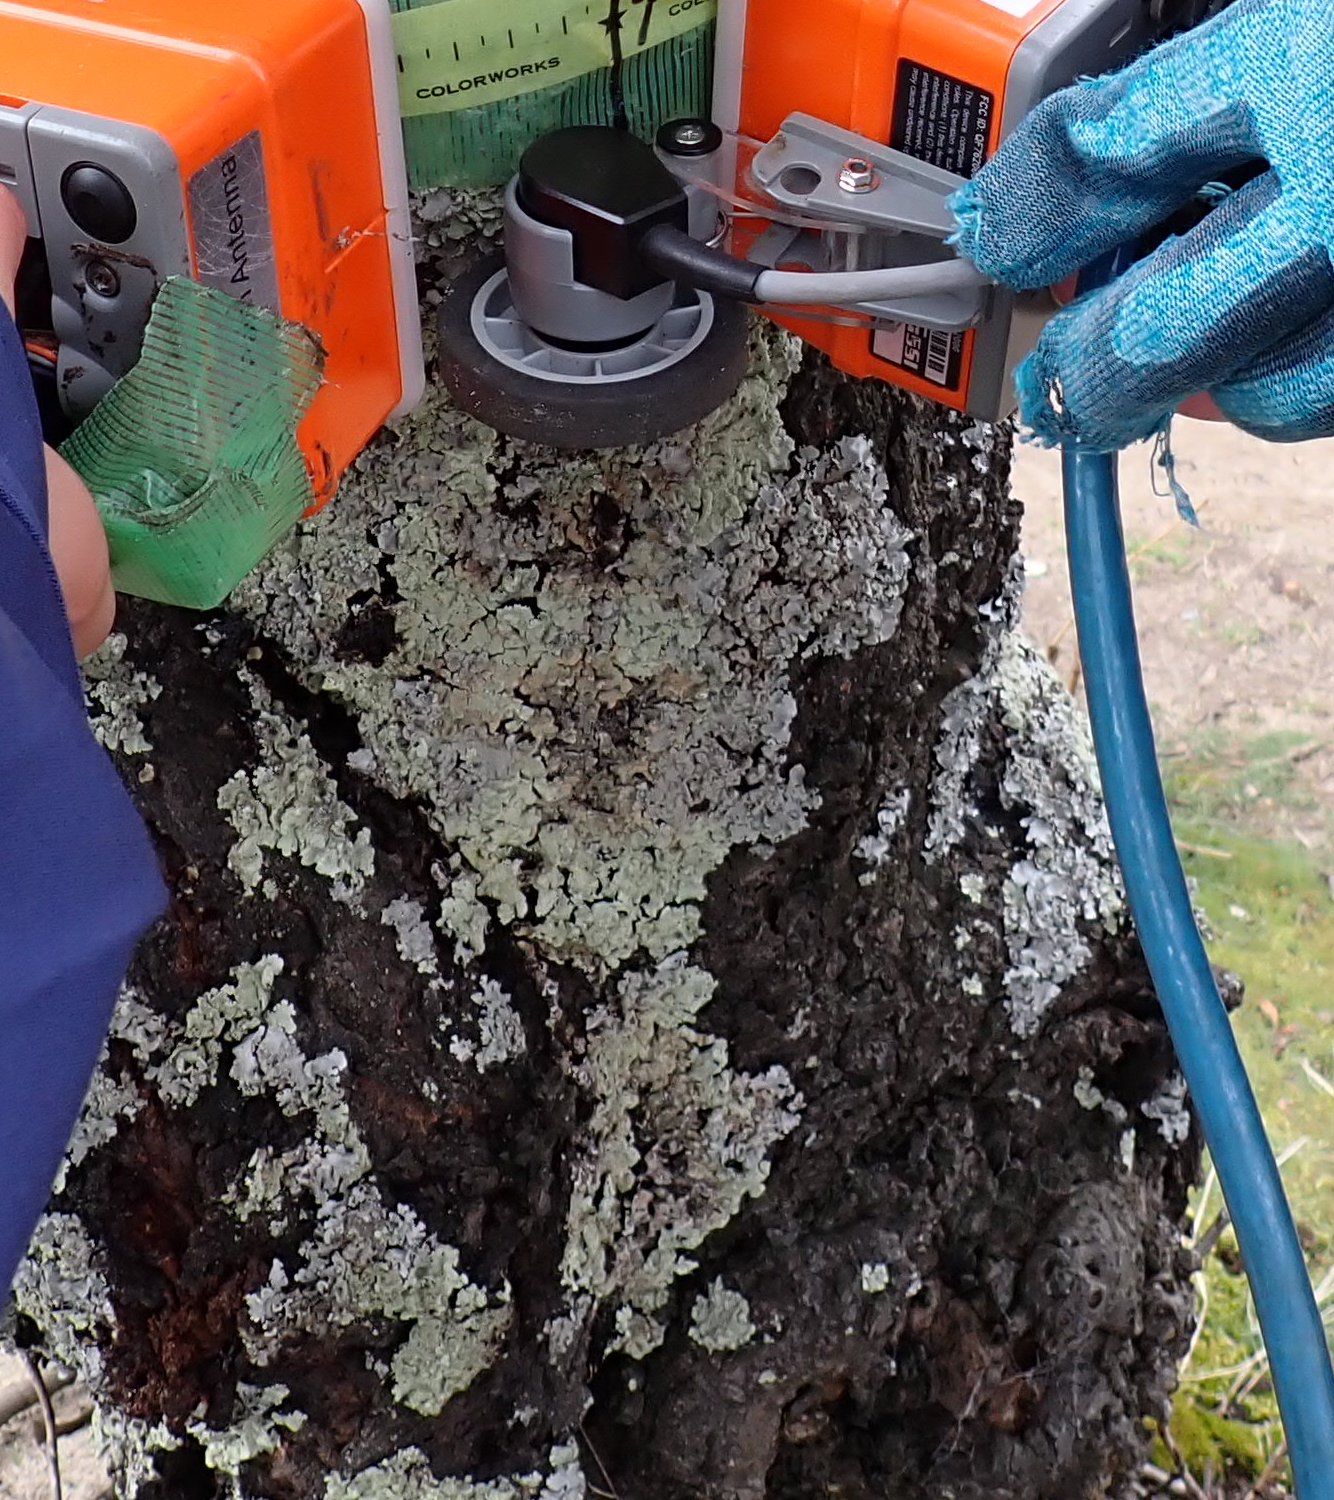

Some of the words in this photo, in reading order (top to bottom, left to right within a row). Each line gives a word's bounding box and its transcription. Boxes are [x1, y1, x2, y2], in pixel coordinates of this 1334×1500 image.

[415, 56, 561, 99] COLORWORKS
[978, 94, 990, 117] FCC
[221, 154, 250, 284] Antenna
